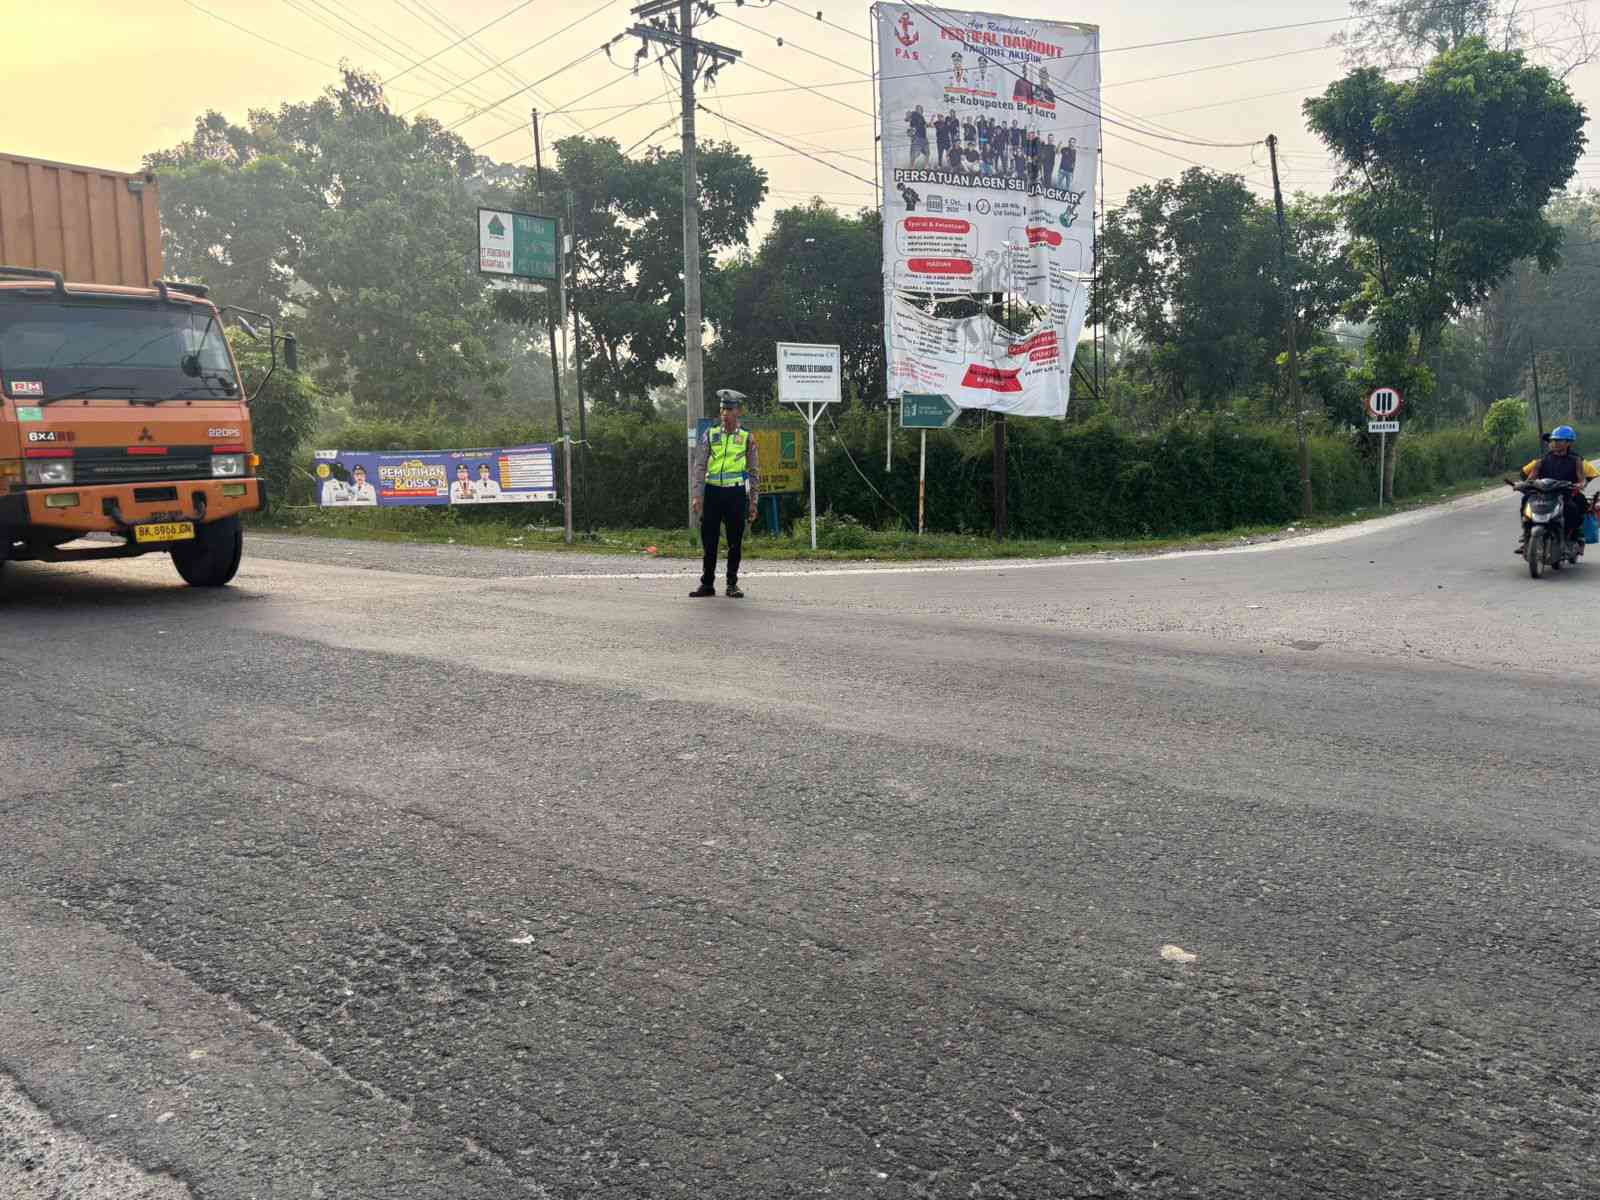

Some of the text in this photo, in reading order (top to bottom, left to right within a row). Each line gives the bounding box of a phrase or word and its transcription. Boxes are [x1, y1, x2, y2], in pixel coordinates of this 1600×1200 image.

[1003, 34, 1064, 58] DANGDUT
[943, 94, 1013, 109] Se-Kabupaten
[895, 169, 970, 187] PERSATUAN
[973, 178, 1006, 190] AGEN
[1008, 181, 1025, 191] SEI
